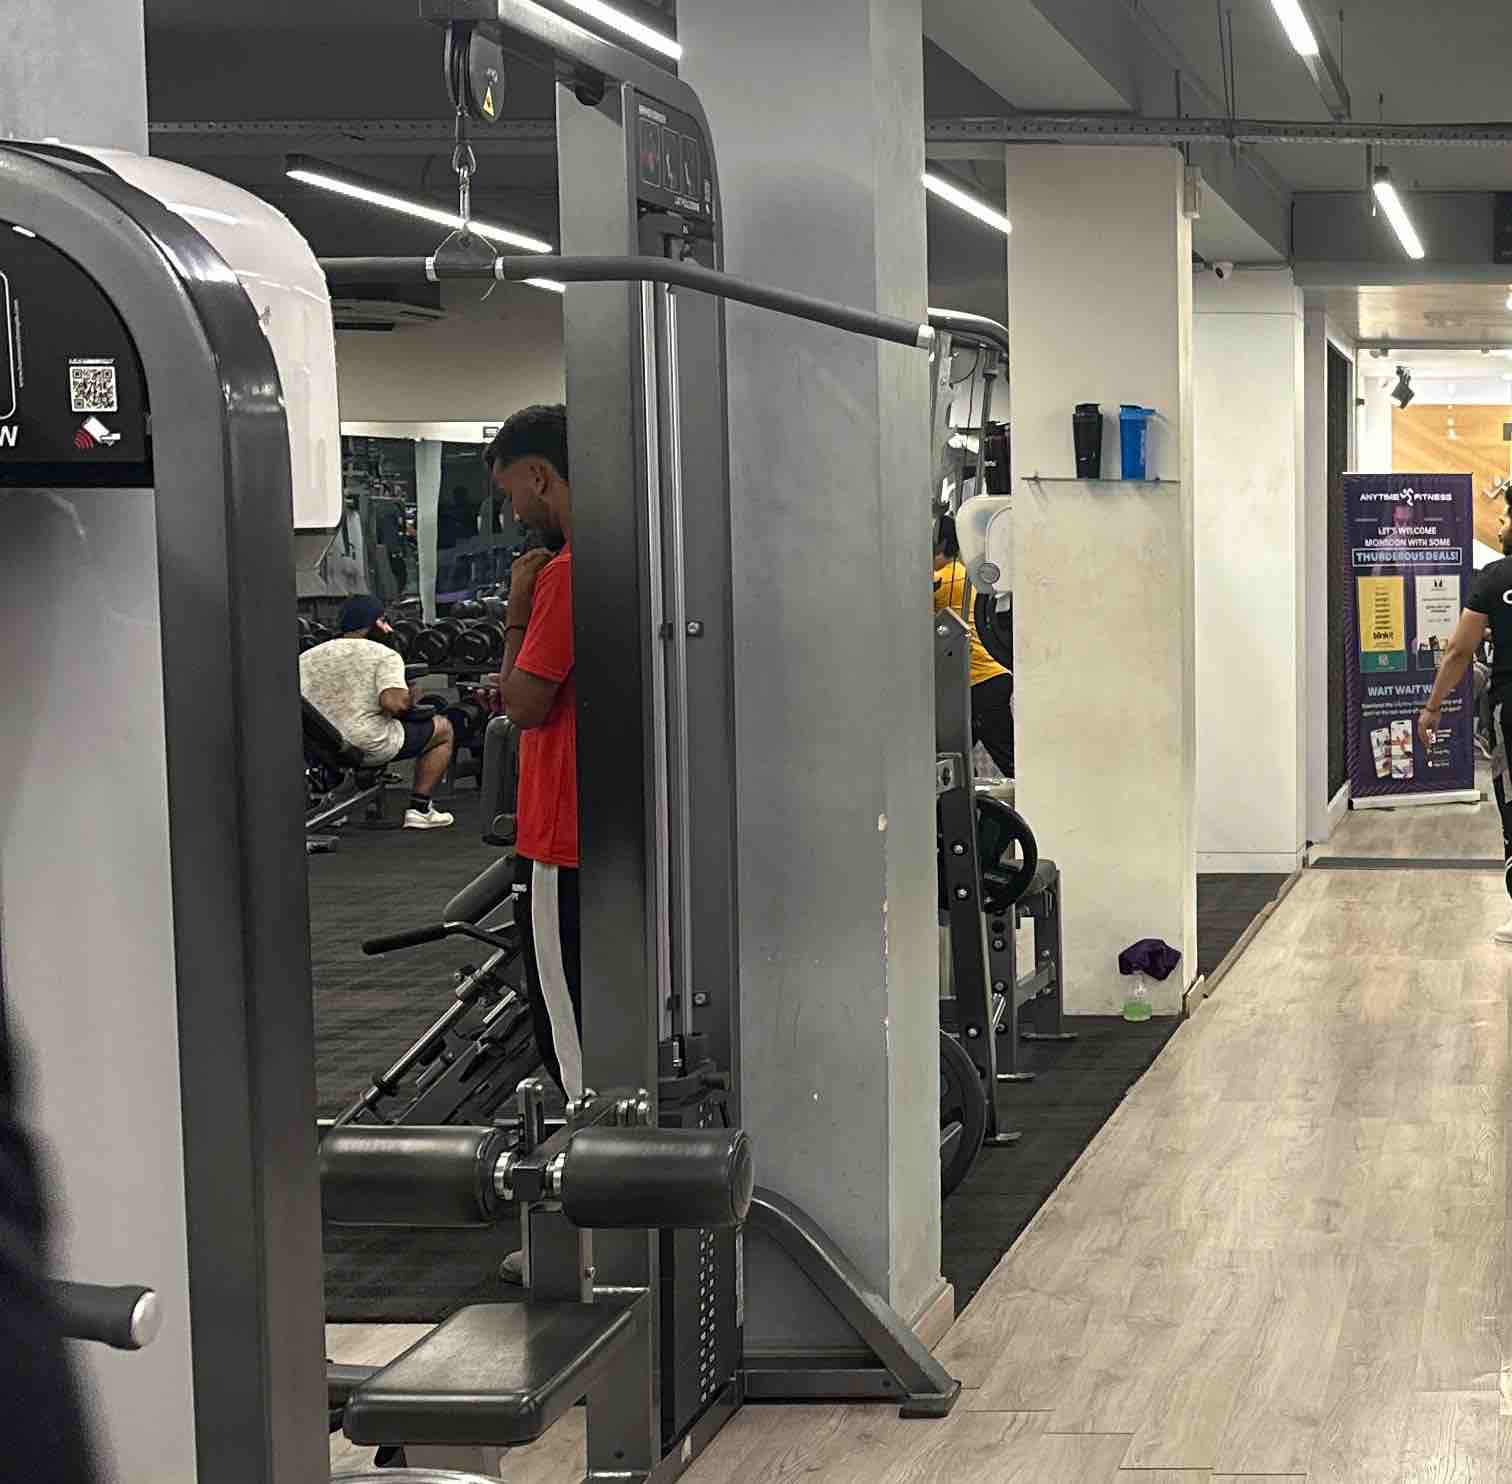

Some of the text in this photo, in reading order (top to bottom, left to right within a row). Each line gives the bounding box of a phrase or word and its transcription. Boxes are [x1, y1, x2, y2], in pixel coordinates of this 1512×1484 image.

[1359, 493, 1452, 501] ANYTIME FITNESS
[1398, 526, 1437, 535] WELCOME
[1407, 538, 1428, 547] WITH
[1428, 537, 1451, 547] SOME
[1368, 686, 1394, 697] WAIT
[1394, 684, 1421, 696] WAIT
